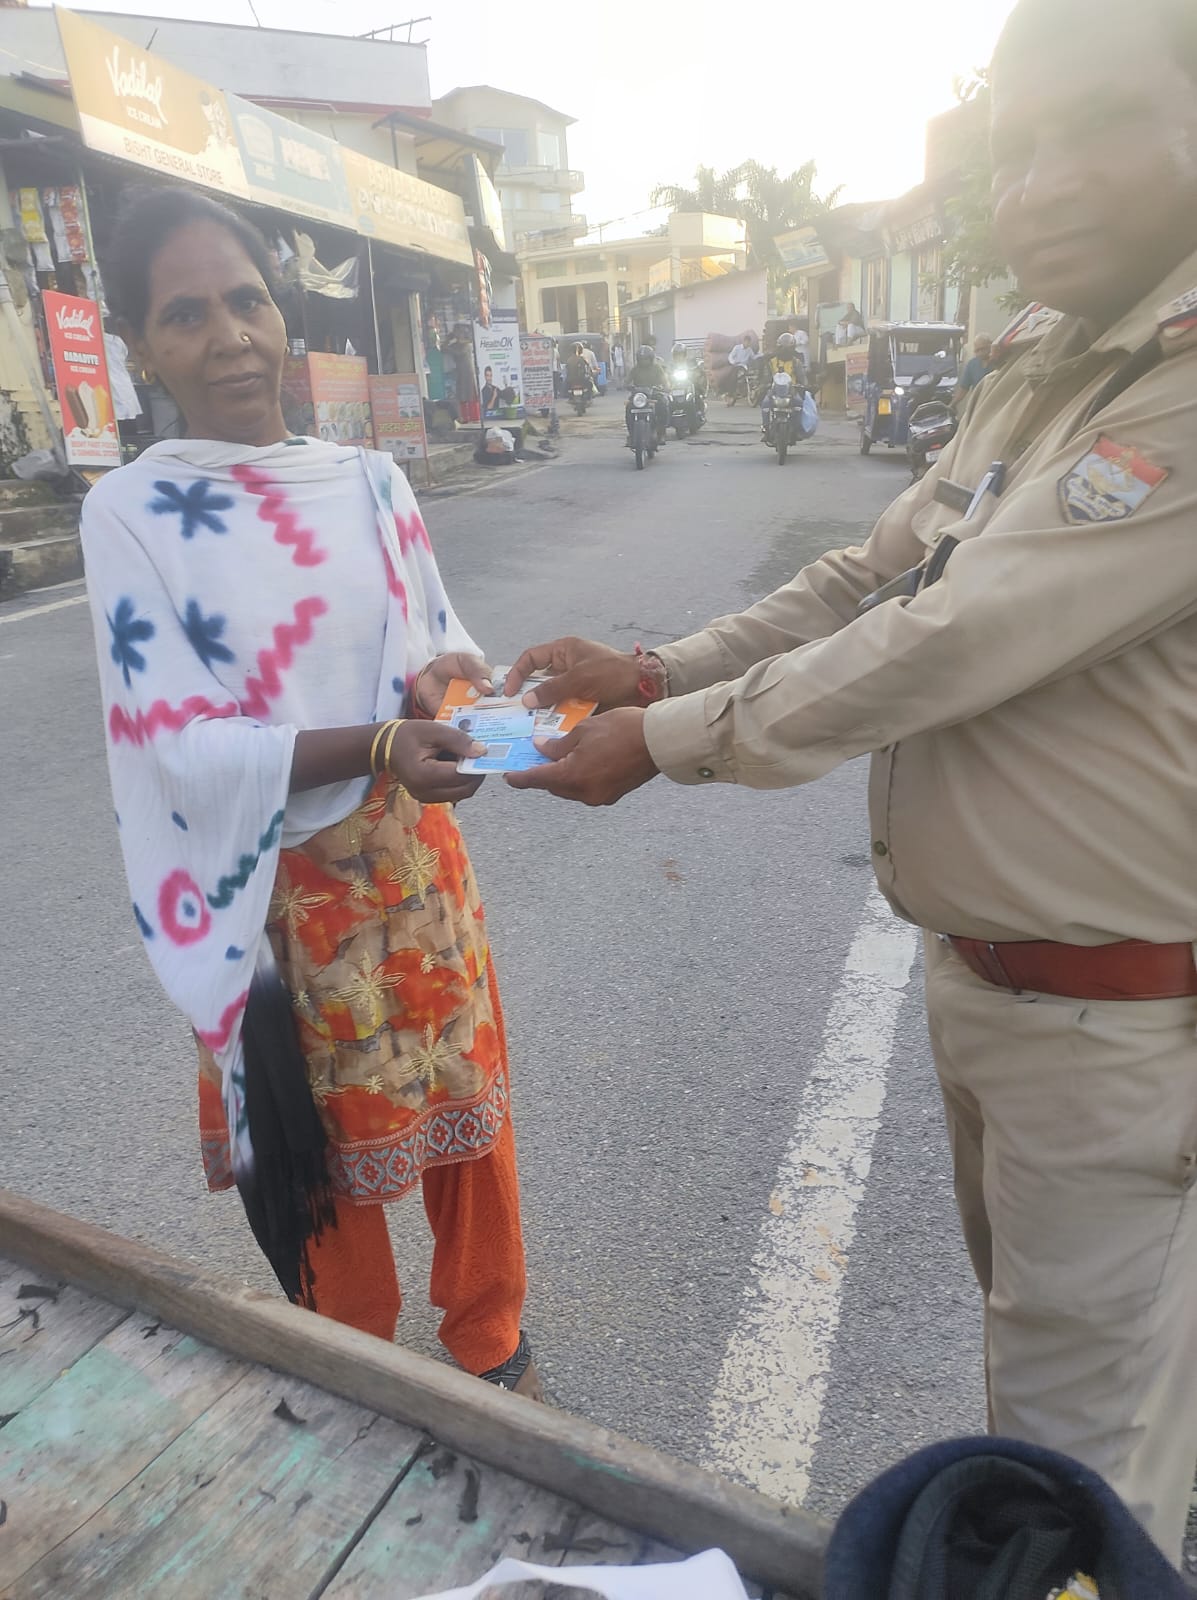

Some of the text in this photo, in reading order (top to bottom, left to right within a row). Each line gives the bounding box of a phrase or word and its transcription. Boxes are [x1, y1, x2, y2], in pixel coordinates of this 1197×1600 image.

[105, 45, 169, 126] Vadilal
[154, 148, 197, 175] GENERAL
[197, 163, 224, 185] STORE
[55, 304, 94, 338] Vadilal
